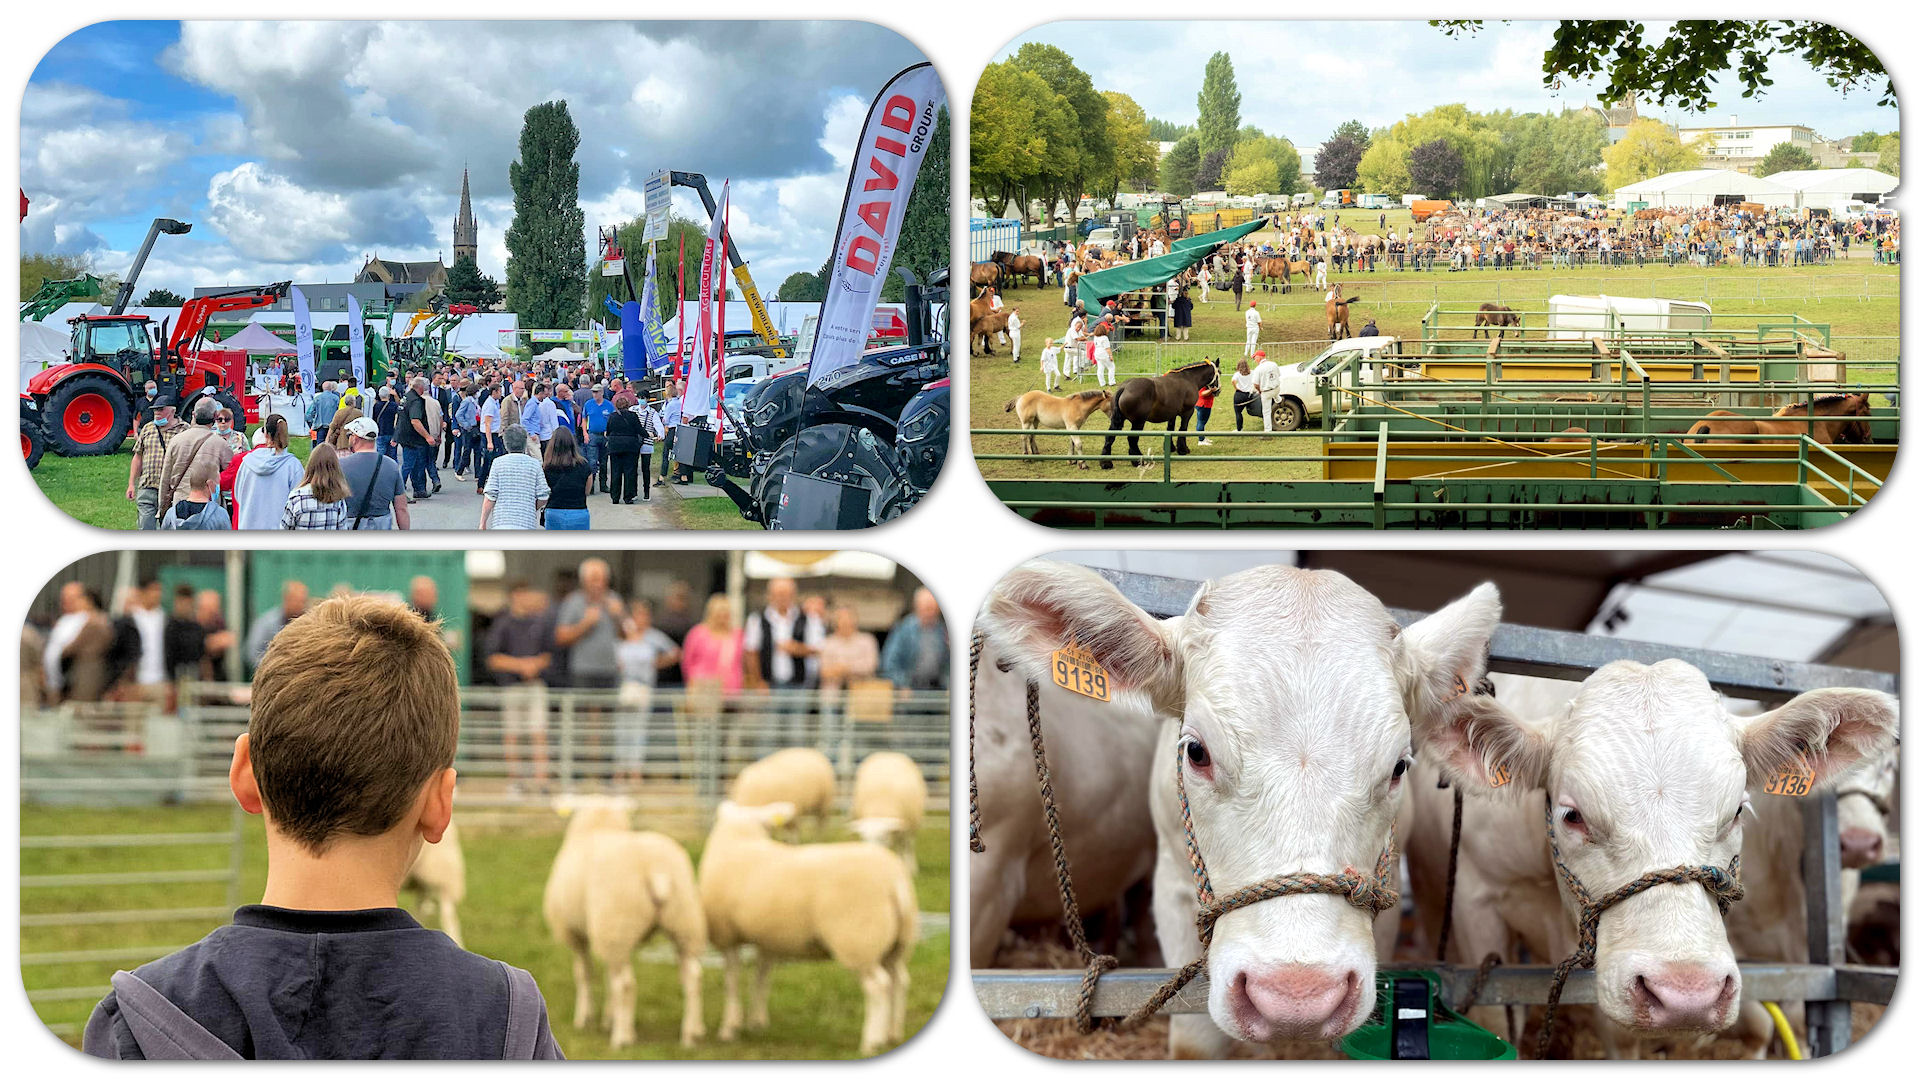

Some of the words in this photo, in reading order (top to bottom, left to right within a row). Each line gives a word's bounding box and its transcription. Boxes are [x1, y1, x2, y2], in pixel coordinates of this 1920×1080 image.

[910, 99, 935, 154] GROUPE
[846, 94, 917, 277] DAVID
[702, 240, 713, 313] AGRICULTURE
[750, 292, 761, 309] NEW
[758, 309, 775, 341] HOLLAND
[818, 370, 841, 387] 270
[889, 352, 918, 365] CASE
[1057, 660, 1107, 699] 9139
[1766, 774, 1810, 795] 9136
